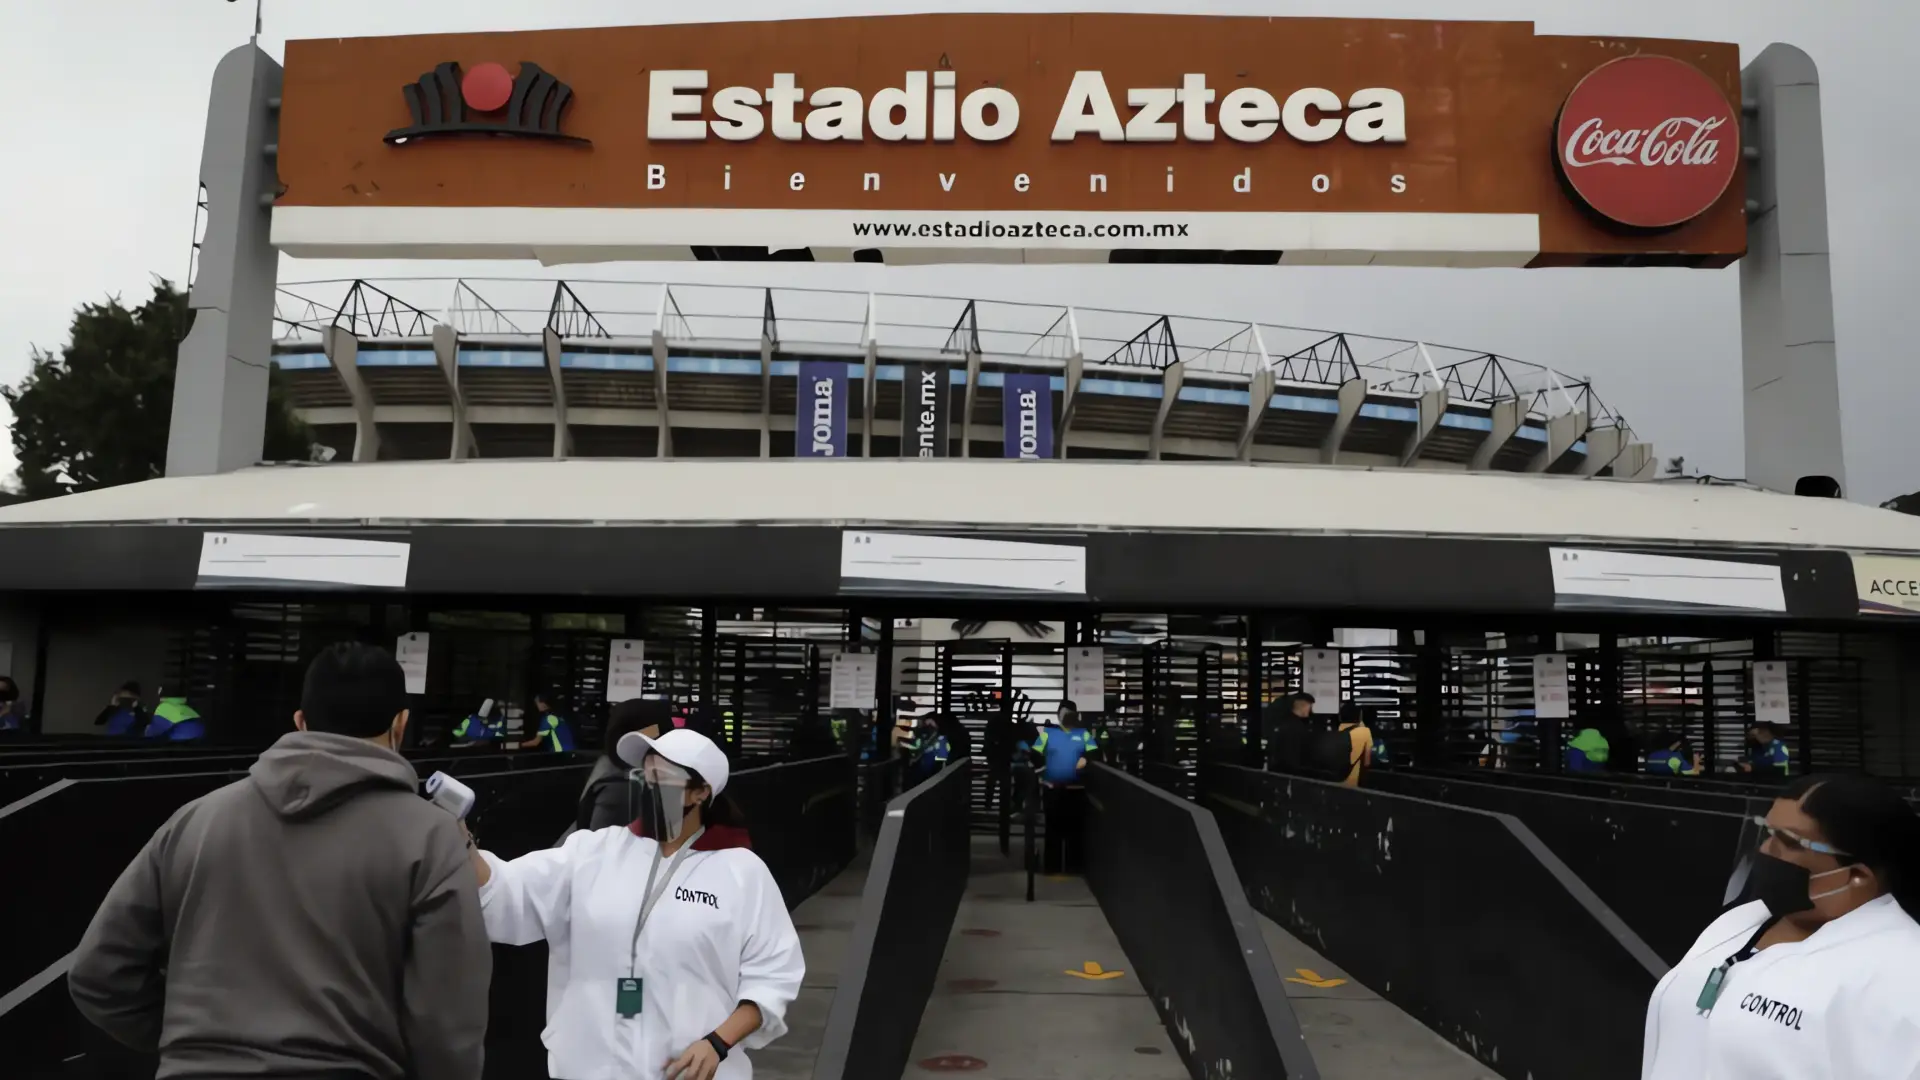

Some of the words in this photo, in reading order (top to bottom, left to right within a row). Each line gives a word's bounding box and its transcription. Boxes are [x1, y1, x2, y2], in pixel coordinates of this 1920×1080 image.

[648, 69, 1020, 141] Estadio
[1050, 70, 1407, 143] Azteca
[1565, 116, 1727, 168] Coca-Cola
[853, 220, 1189, 238] www.estadioazteca.com.mx
[1870, 579, 1920, 597] ACCE
[675, 886, 719, 910] CONTROL
[1740, 992, 1804, 1031] CONTROL
